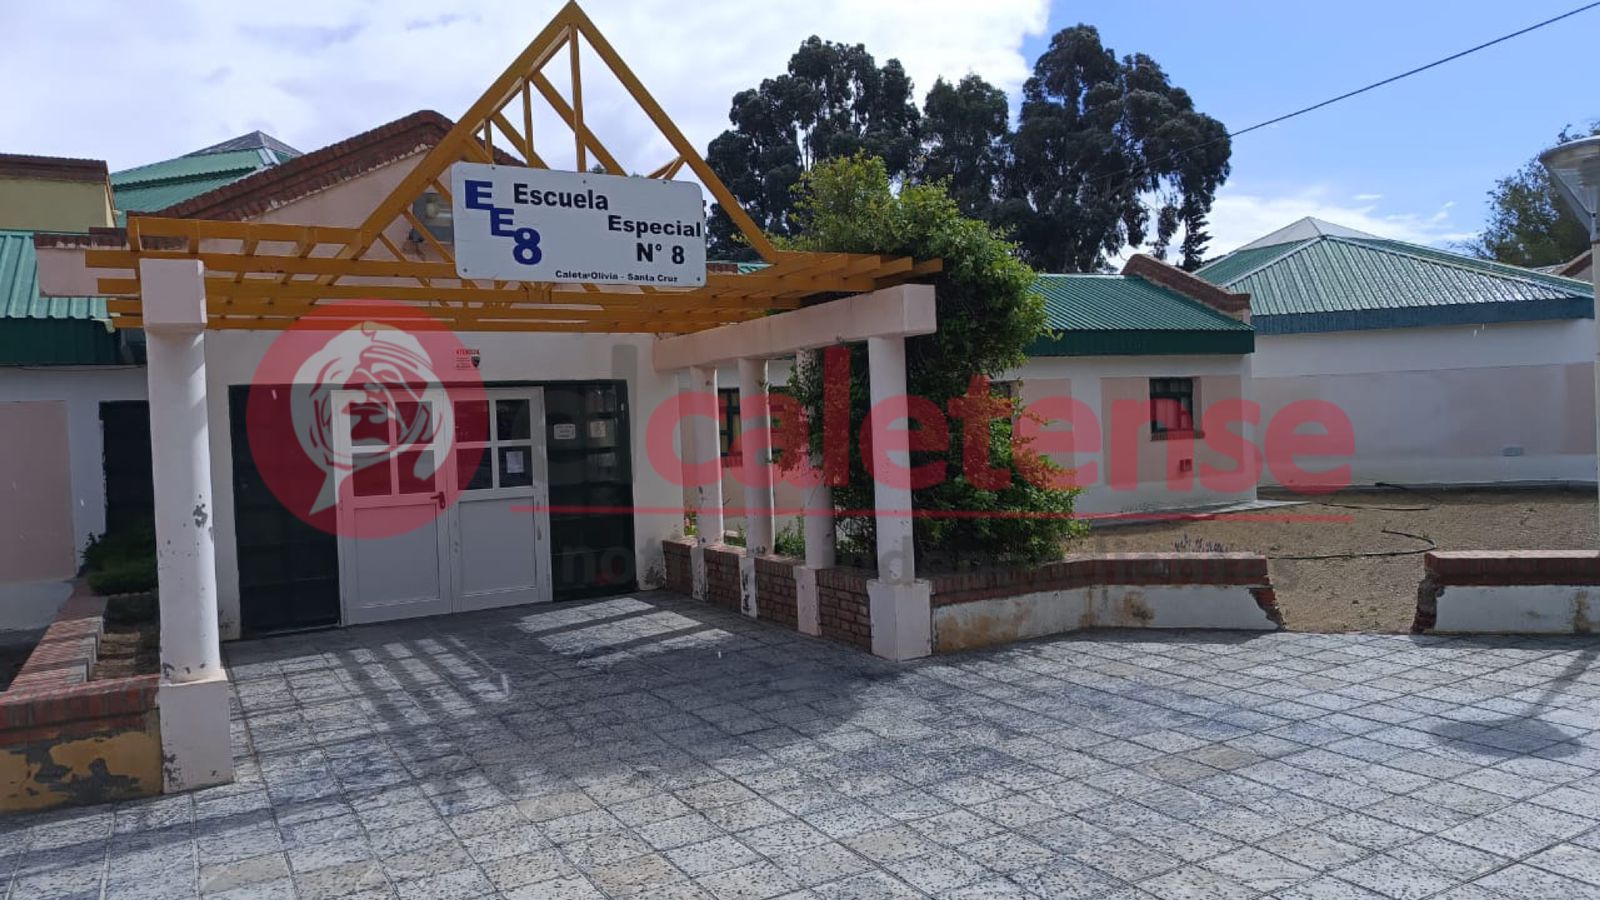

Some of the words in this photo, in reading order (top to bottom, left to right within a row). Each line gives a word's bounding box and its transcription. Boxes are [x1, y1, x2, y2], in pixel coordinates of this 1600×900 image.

[513, 183, 608, 210] Escuela
[608, 215, 701, 238] Especial
[636, 243, 662, 262] N°
[671, 245, 685, 265] 8
[555, 270, 588, 280] Caleta
[590, 271, 618, 280] Olivia
[627, 273, 655, 282] Santa
[657, 274, 678, 282] Cruz
